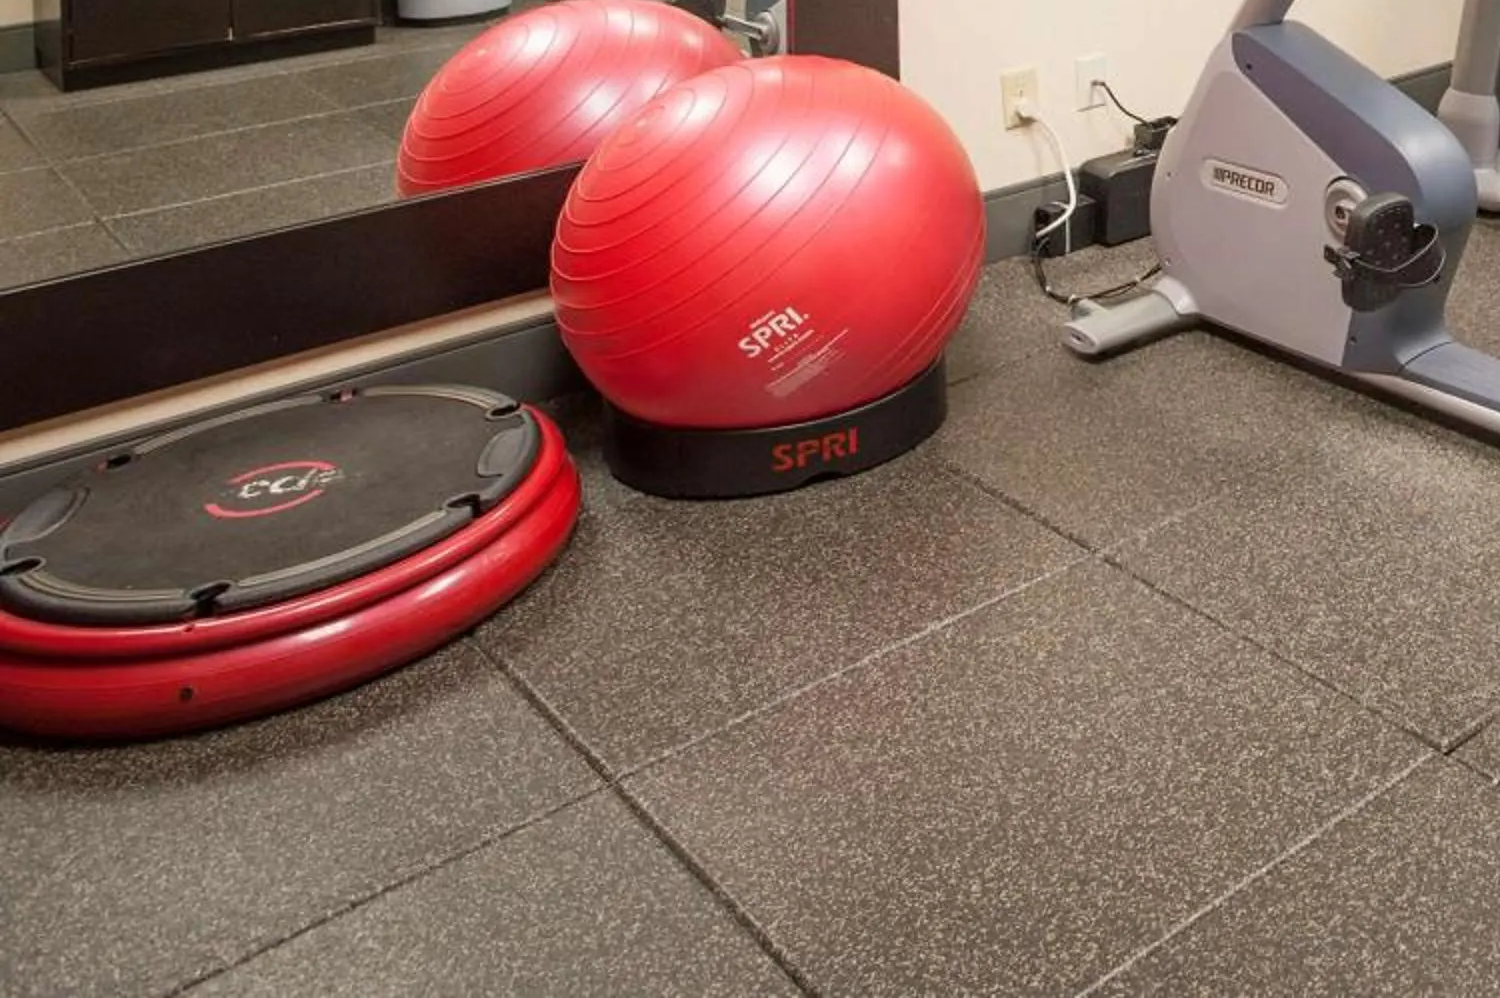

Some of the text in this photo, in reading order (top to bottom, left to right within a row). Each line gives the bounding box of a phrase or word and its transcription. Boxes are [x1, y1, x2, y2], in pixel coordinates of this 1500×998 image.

[1221, 168, 1275, 196] PRECOR
[737, 305, 805, 359] SPRI
[771, 425, 859, 472] SPRI
